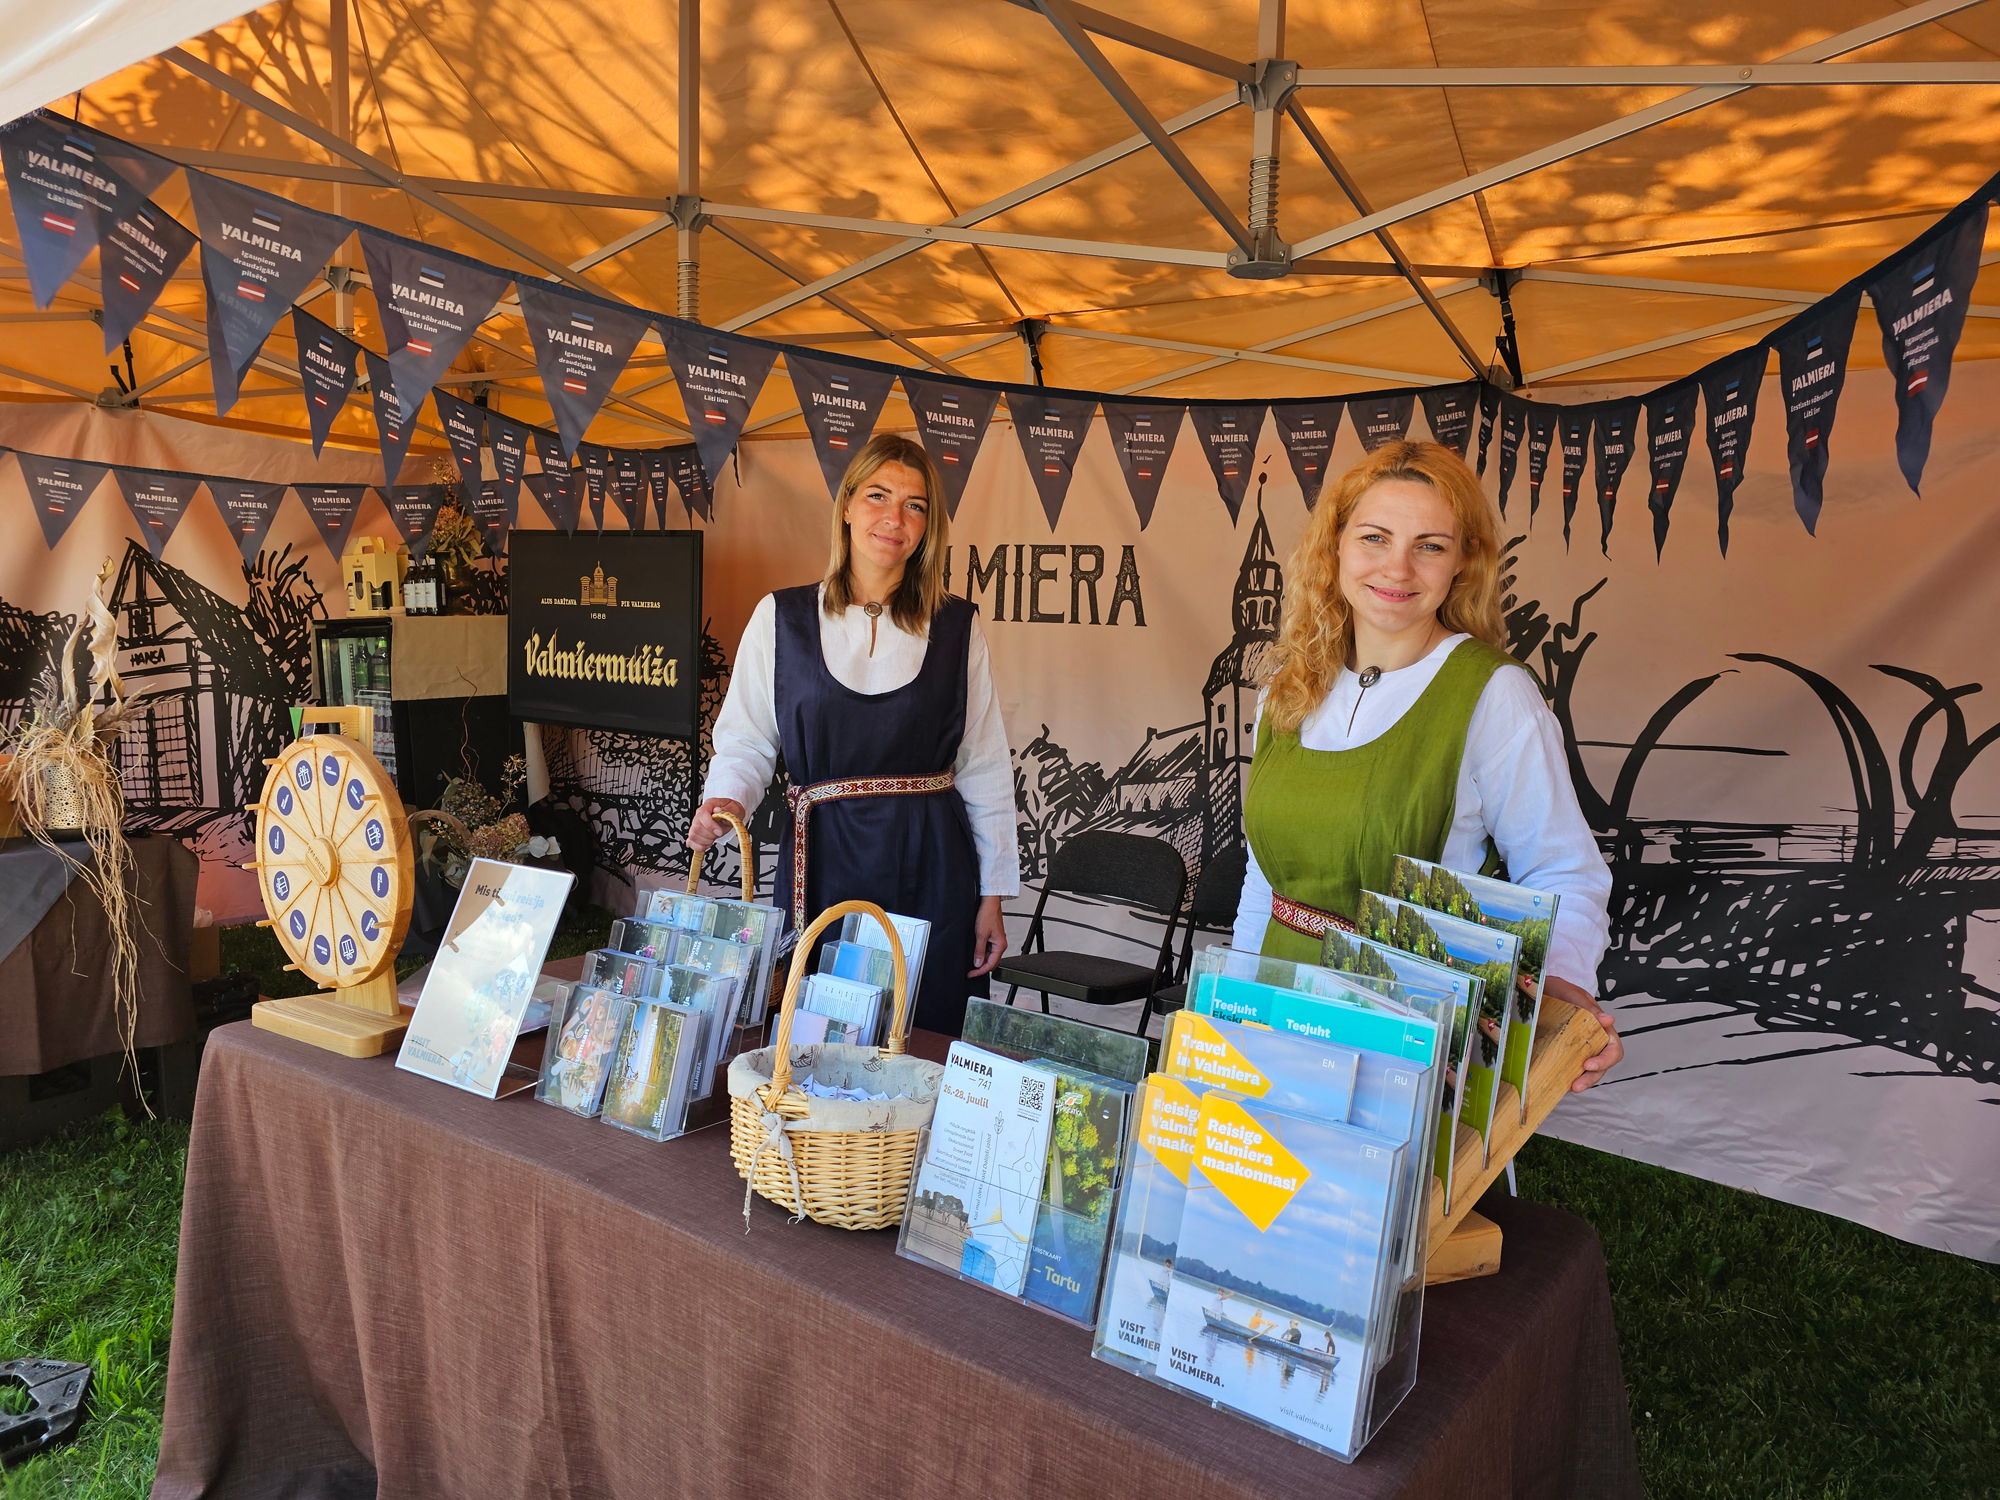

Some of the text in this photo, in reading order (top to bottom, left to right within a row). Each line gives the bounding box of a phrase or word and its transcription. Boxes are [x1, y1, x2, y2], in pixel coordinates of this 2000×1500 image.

[28, 150, 117, 196] VALMIERA
[221, 222, 302, 262] VALMIERA
[241, 250, 276, 267] Igauņiem
[241, 270, 268, 283] pilsēta
[392, 283, 464, 316] VALMIERA
[388, 303, 421, 318] Eestlaste
[1892, 287, 1953, 341] VALMIERA
[408, 320, 438, 333] Läti linn
[547, 328, 613, 355] VALMIERA
[687, 363, 746, 386] VALMIERA
[1791, 361, 1835, 397] VALMIERA
[812, 392, 867, 411] VALMIERA
[926, 411, 975, 428] VALMIERA
[1029, 425, 1074, 440] VALMIERA
[1124, 432, 1165, 443] VALMIERA
[1210, 434, 1249, 446] VALMIERA
[1291, 430, 1327, 442] VALMIERA
[37, 477, 83, 491] VALMIERA
[135, 493, 178, 504] VALMIERA
[227, 501, 268, 509] VALMIERA
[312, 497, 351, 505] VALMIERA
[395, 504, 432, 512] VALMIERA
[621, 600, 661, 609] PIE VALMIERAS
[590, 612, 607, 620] 1688
[130, 647, 166, 667] HANSA
[524, 627, 679, 688] Valmiermuiža
[475, 884, 491, 897] Mis
[517, 893, 544, 909] reisija
[1214, 999, 1257, 1017] Teejuht
[1286, 1018, 1331, 1038] Teejuht
[411, 1034, 431, 1048] VISIT
[1180, 1034, 1227, 1057] Travel
[408, 1046, 444, 1066] VALMIERA.
[951, 1053, 993, 1077] VALMIERA
[1322, 1058, 1335, 1069] EN
[1176, 1053, 1190, 1067] in
[1194, 1056, 1260, 1087] Valmiera
[978, 1077, 992, 1091] 741
[1394, 1075, 1408, 1086] RU
[966, 1092, 989, 1109] juulil
[1151, 1114, 1198, 1138] Valmie
[1207, 1118, 1263, 1145] Reisige
[1205, 1135, 1273, 1166] Valmiera
[1366, 1148, 1378, 1159] ET
[1202, 1155, 1297, 1189] maakonnas!
[1045, 1266, 1081, 1294] Tartu
[1119, 1319, 1146, 1335] VISIT
[1118, 1330, 1160, 1352] VALMIER
[1171, 1346, 1198, 1364] VISIT
[1169, 1358, 1225, 1388] VALMIERA.
[1279, 1405, 1334, 1433] visit.valmiera.lv
